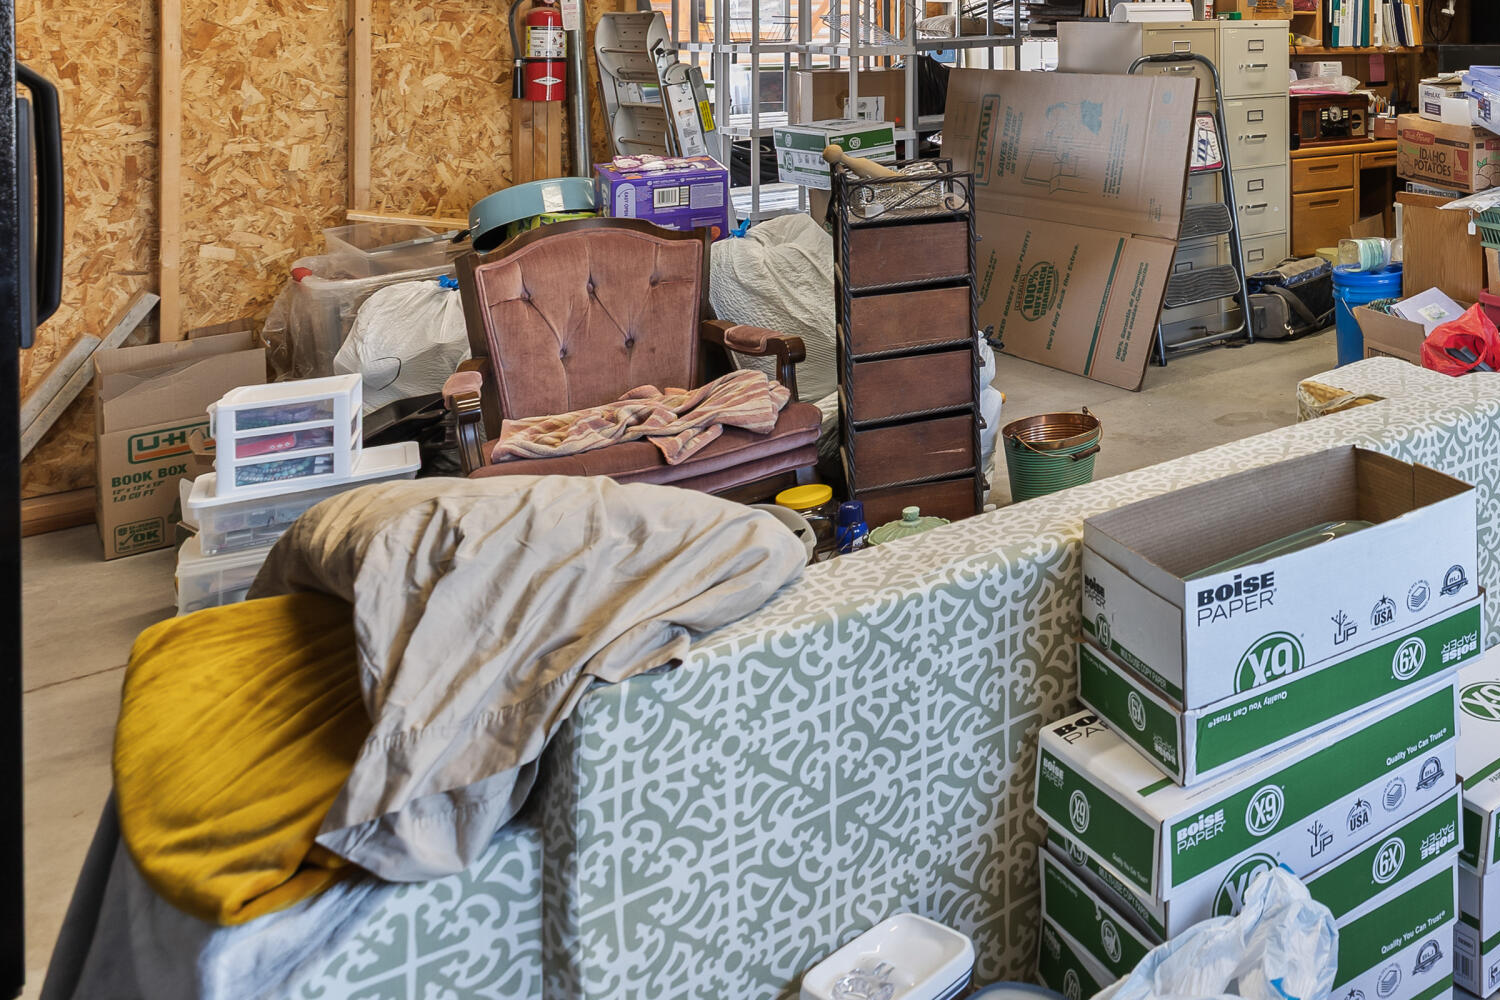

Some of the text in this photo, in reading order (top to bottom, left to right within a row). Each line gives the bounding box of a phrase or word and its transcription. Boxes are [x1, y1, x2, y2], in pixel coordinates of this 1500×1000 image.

[976, 100, 995, 178] U-HAUL
[1414, 158, 1452, 177] POTATOES
[1420, 147, 1447, 163] IDAHO
[1023, 270, 1040, 312] 100%
[112, 464, 188, 487] BOOK BOX
[133, 529, 160, 543] OK
[1197, 590, 1275, 627] PAPER
[1374, 609, 1393, 627] USA
[1150, 668, 1168, 688] PAPER
[1232, 690, 1288, 718] Quality You Can
[1386, 739, 1429, 767] Quality You Can
[1349, 813, 1369, 832] USA
[1177, 821, 1226, 855] PAPER
[1381, 923, 1427, 955] Quality You Can
